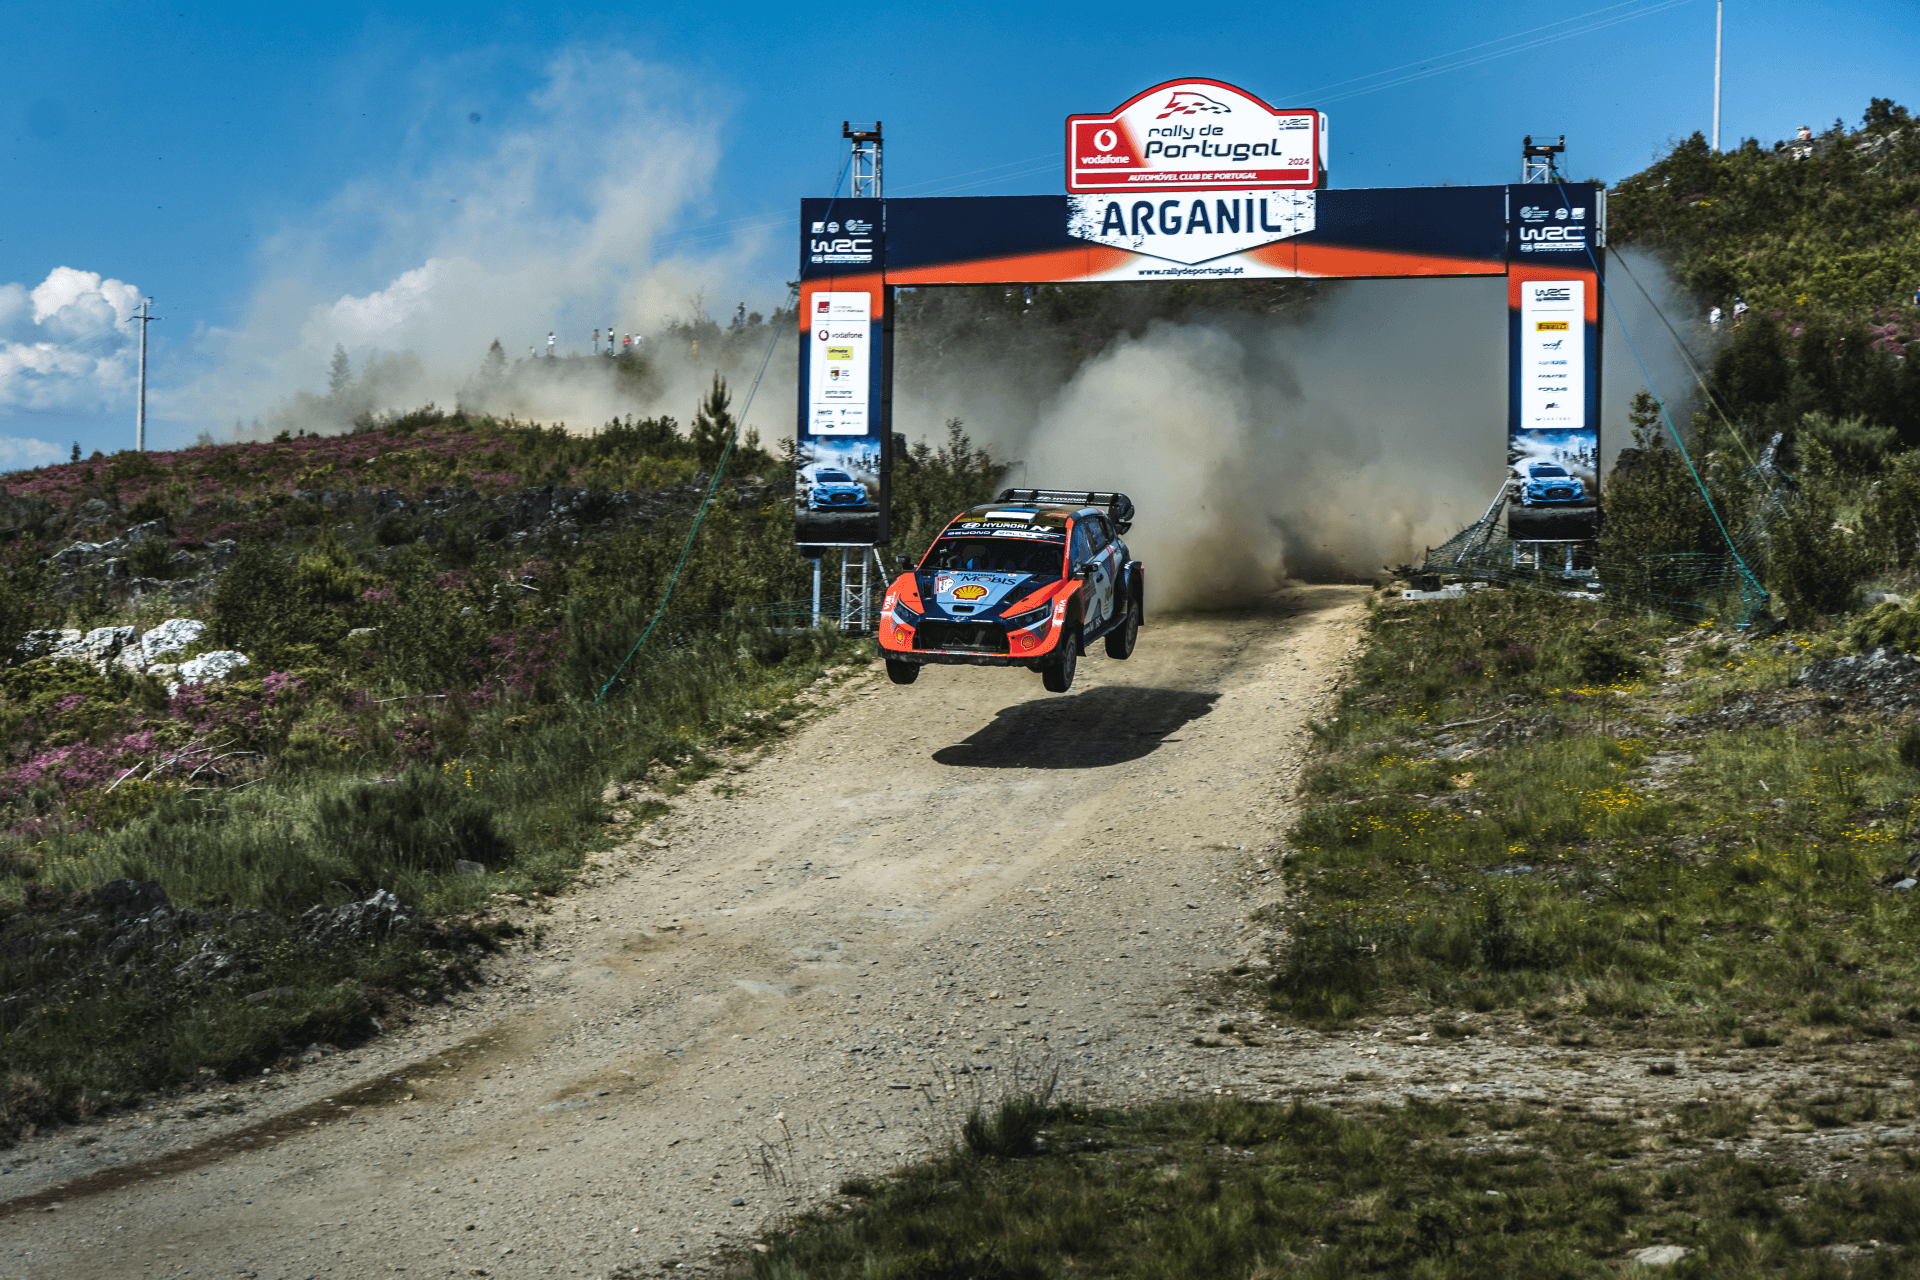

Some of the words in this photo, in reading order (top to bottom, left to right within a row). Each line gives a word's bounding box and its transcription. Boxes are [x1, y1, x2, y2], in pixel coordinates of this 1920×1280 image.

[1148, 124, 1195, 140] rally
[1199, 124, 1224, 136] de
[1144, 138, 1283, 162] Portugal
[1080, 154, 1130, 165] vodafone
[1287, 157, 1310, 166] 2024
[1127, 172, 1178, 182] AUTOMÓVEL
[1178, 173, 1200, 181] CLUB
[1200, 173, 1214, 181] DE
[1214, 172, 1258, 181] PORTUGAL
[1099, 198, 1282, 236] ARGANIL
[1519, 226, 1586, 241] WRC
[811, 238, 873, 253] WRC
[1137, 266, 1244, 277] www.rallydeportugal.pt
[1535, 288, 1570, 296] WRC
[981, 522, 1028, 530] HYUNDAI
[960, 576, 1017, 585] MOBIS
